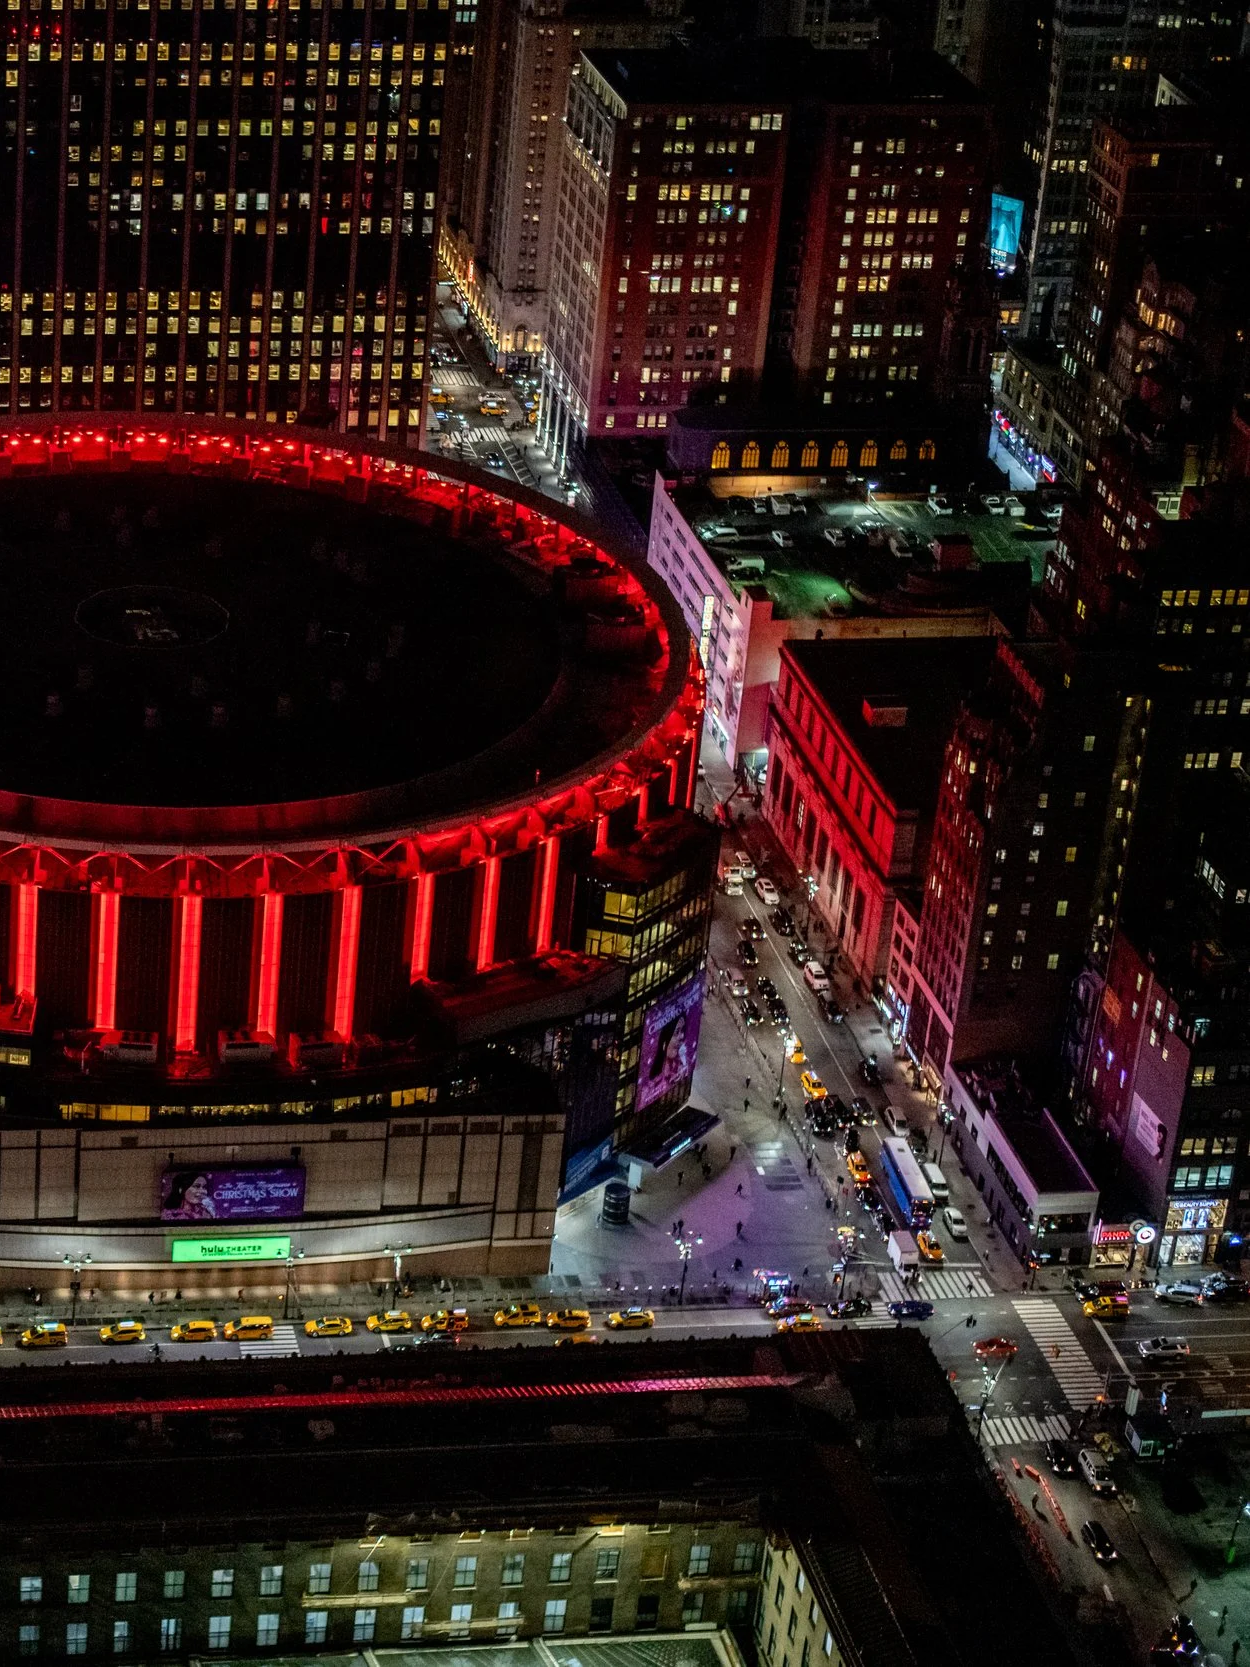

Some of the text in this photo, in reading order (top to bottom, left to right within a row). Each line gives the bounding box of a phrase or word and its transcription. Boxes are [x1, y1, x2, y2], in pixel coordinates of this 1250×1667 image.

[213, 1187, 299, 1200] CHRISTMAS SHOW
[1180, 1198, 1219, 1208] BEAUTY SUPPLY
[200, 1245, 224, 1253] hulu
